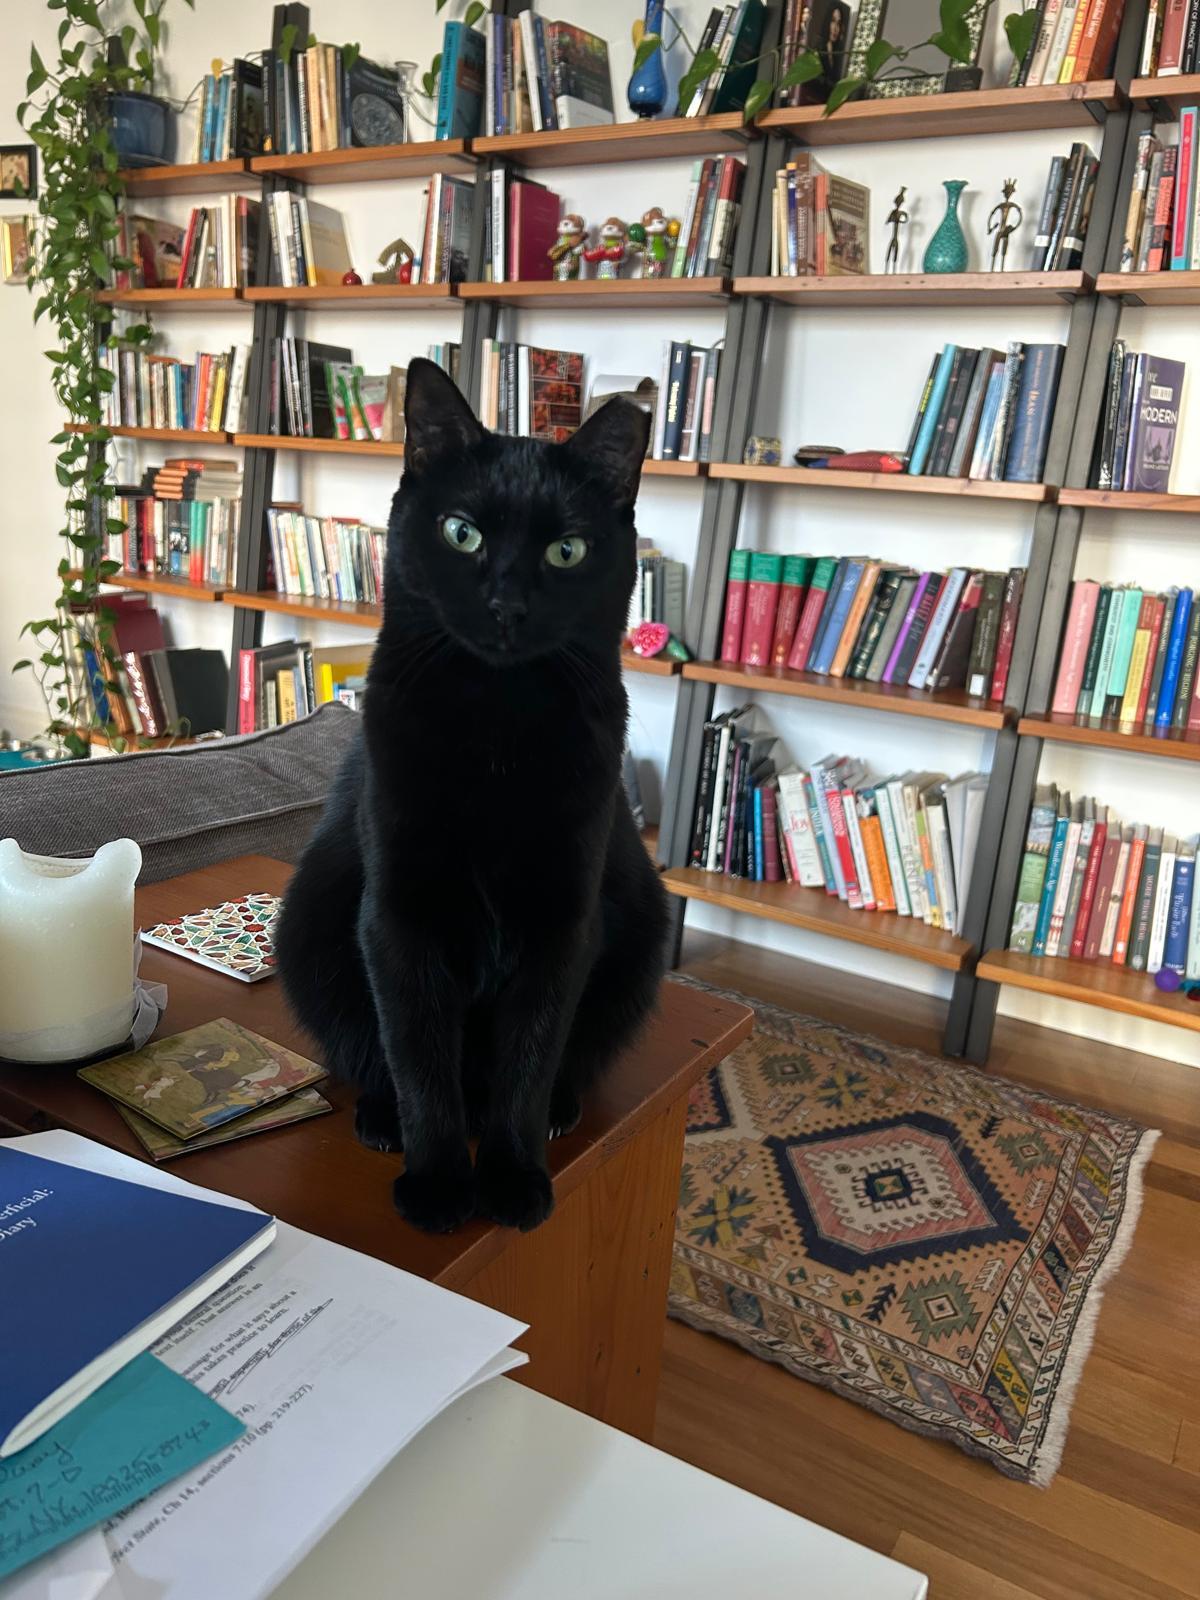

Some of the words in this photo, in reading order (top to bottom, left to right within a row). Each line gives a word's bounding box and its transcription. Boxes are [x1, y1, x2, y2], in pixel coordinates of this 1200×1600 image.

[195, 1312, 217, 1327] That
[210, 1340, 226, 1354] for
[224, 1326, 246, 1343] what
[243, 1320, 254, 1329] it
[251, 1308, 271, 1324] says
[268, 1294, 291, 1311] about
[203, 1353, 228, 1373] takes
[226, 1330, 260, 1357] practice
[257, 1322, 268, 1334] to
[161, 1499, 183, 1517] Ch
[197, 1452, 236, 1486] sections
